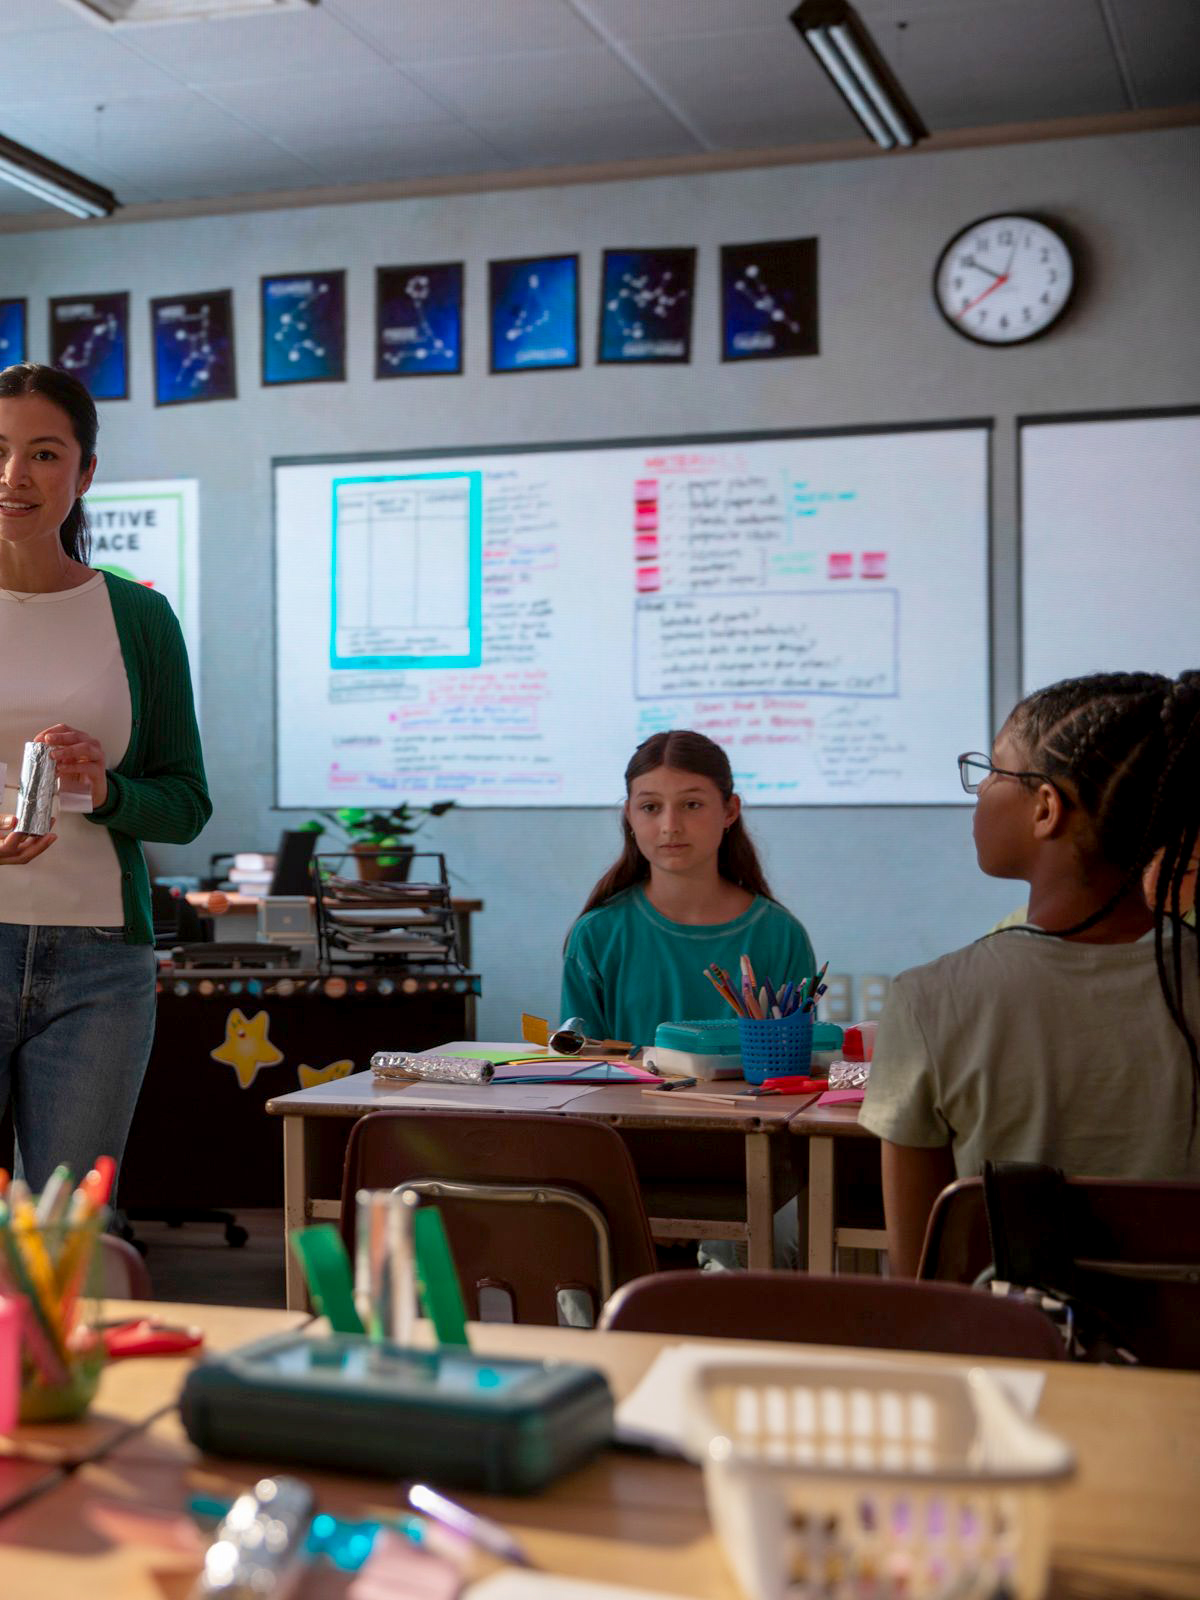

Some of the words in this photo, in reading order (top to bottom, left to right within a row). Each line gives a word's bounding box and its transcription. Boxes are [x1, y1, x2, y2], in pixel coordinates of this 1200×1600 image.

[1041, 247, 1049, 263] 2
[999, 314, 1009, 328] 6
[1022, 306, 1031, 322] 5
[94, 533, 140, 551] ACE
